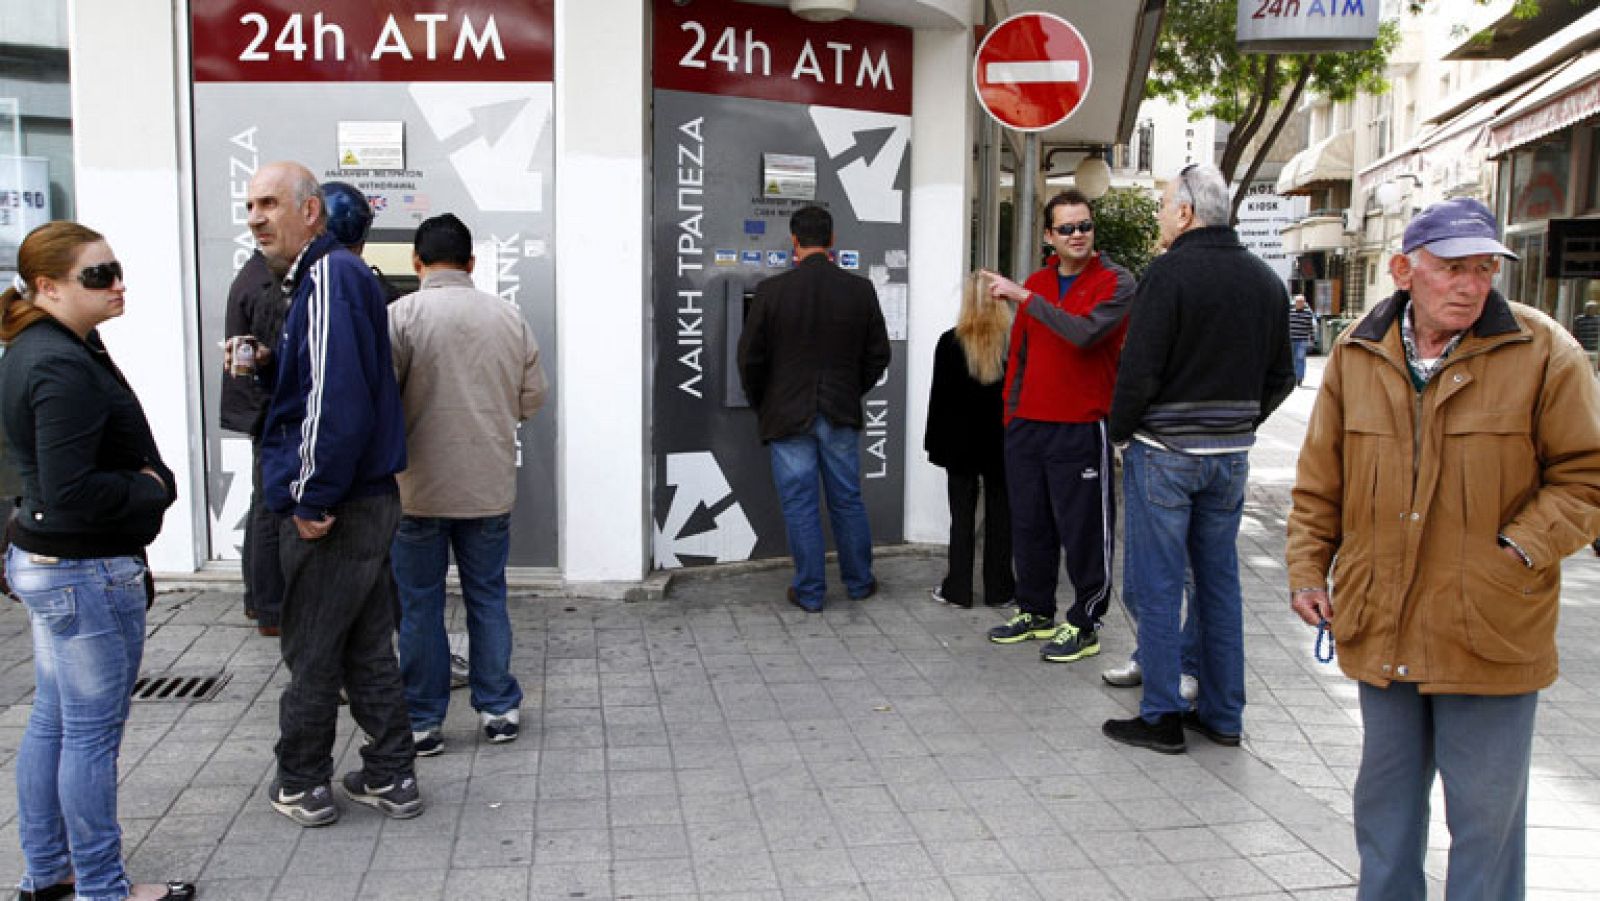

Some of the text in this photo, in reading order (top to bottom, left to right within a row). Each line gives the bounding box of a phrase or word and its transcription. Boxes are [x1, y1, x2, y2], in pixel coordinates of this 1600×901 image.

[239, 12, 506, 61] 24h ATM
[1250, 0, 1365, 19] 24h ATM
[679, 21, 894, 91] 24h ATM
[230, 126, 259, 278] ΡΑΠΕΖΑ
[1248, 202, 1278, 212] KIOSK
[490, 232, 520, 310] ANK
[677, 116, 704, 399] ΛΑΙΚΗ ΤΡΑΠΕΖΑ
[865, 400, 888, 479] LAIKI
